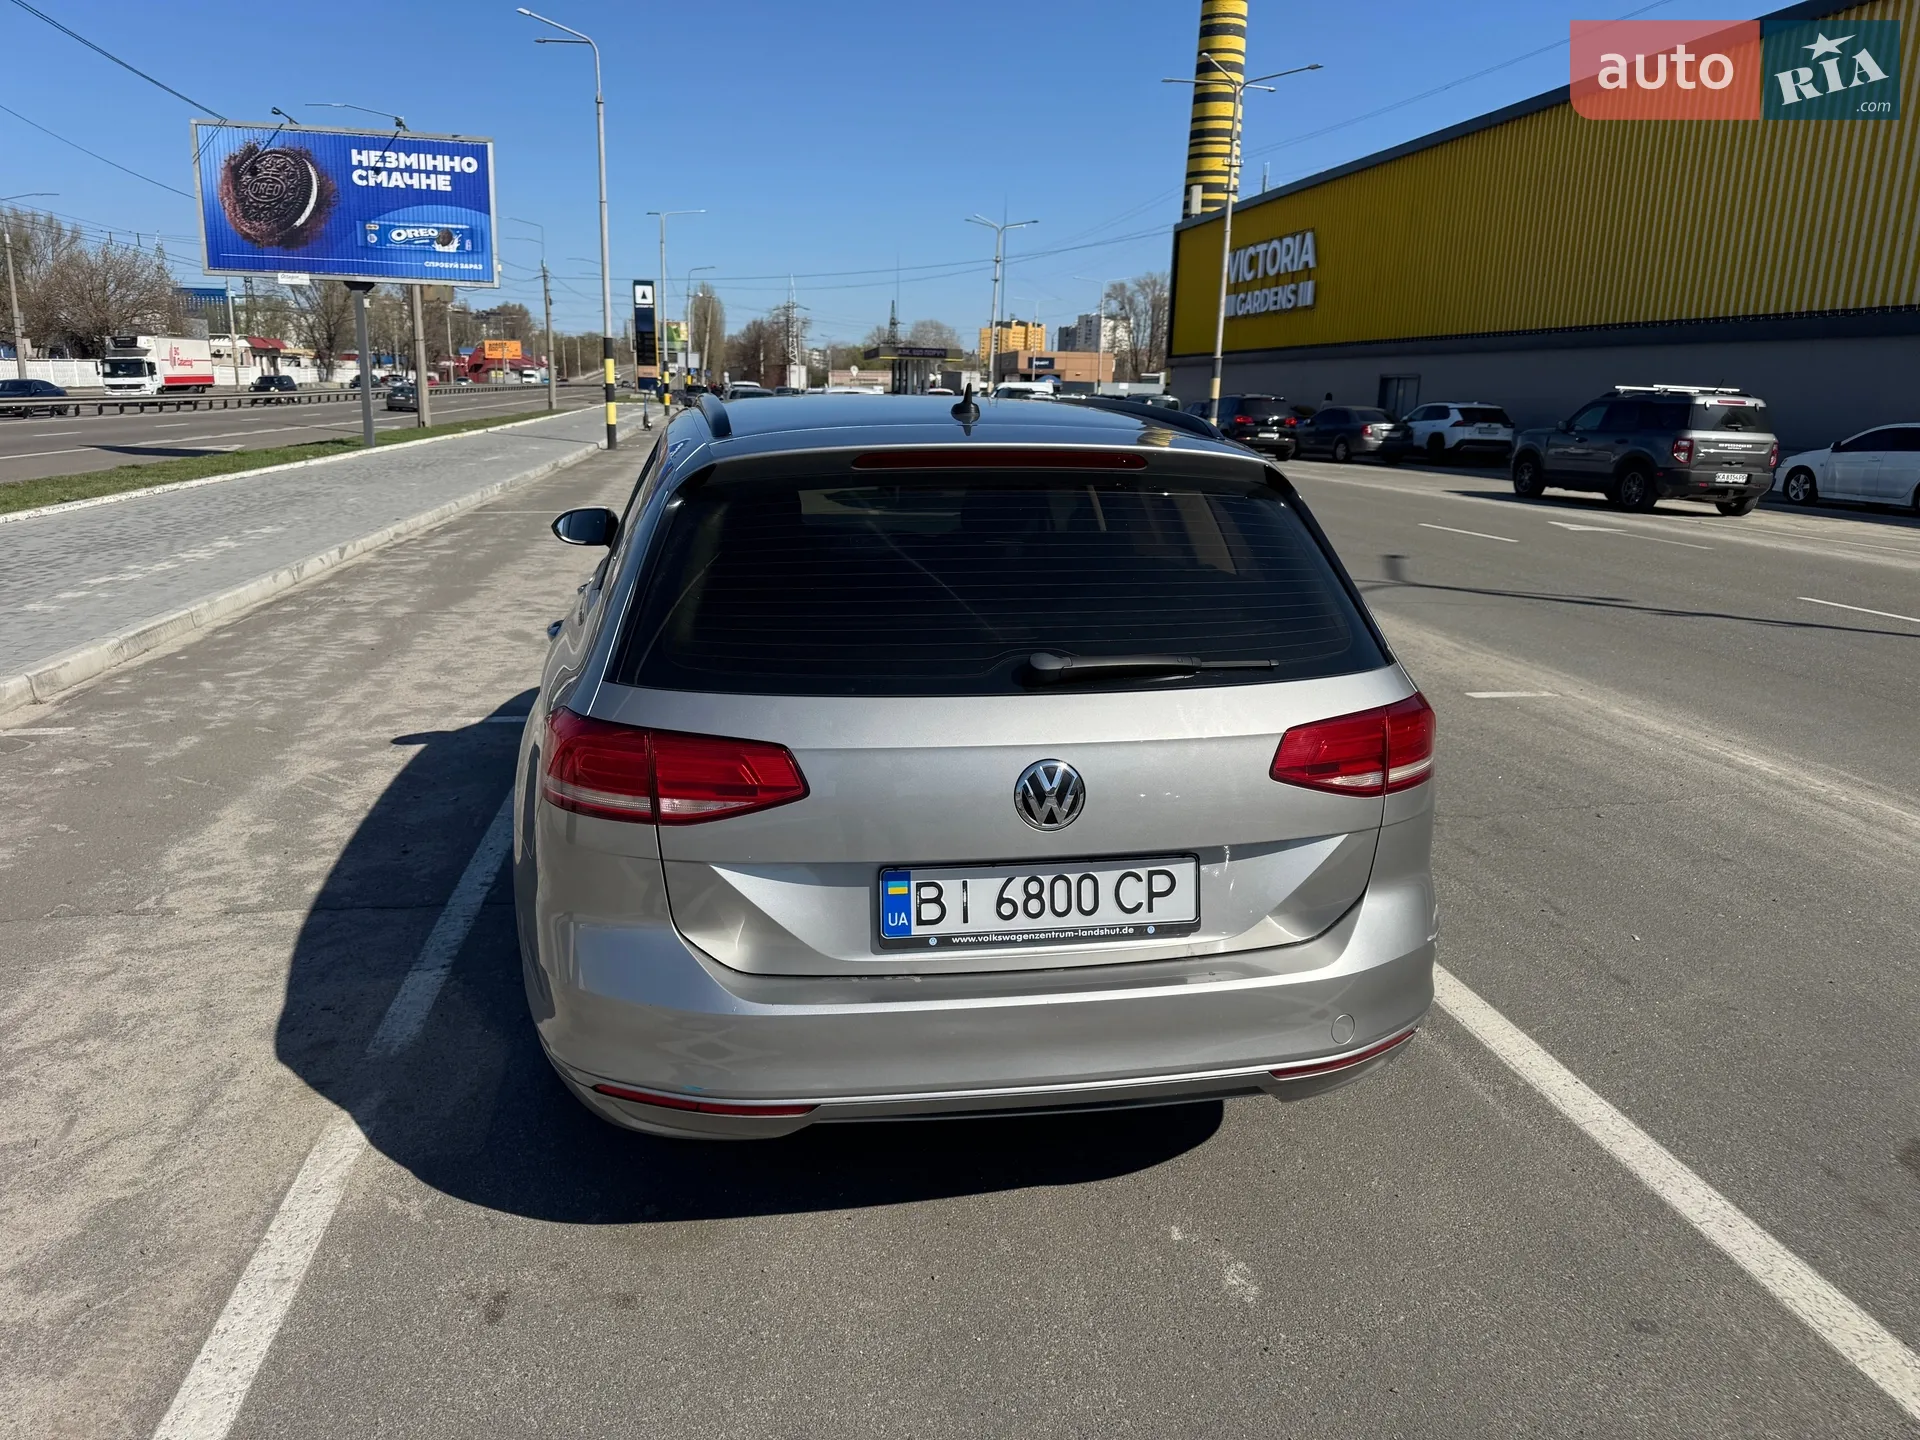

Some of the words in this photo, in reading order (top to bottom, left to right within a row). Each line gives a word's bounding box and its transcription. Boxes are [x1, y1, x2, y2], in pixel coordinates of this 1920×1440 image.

[351, 149, 478, 173] НЕЗМІННО
[251, 182, 281, 196] OREO
[351, 169, 452, 191] СМАЧНЕ
[391, 228, 438, 241] OREO
[1229, 231, 1316, 284] VICTORIA
[1236, 283, 1296, 315] GARDENS
[995, 872, 1099, 921] 6800
[1114, 869, 1177, 914] CP
[888, 912, 909, 927] UA
[952, 926, 1134, 944] www.volkswagenzentrum-landshut.de
